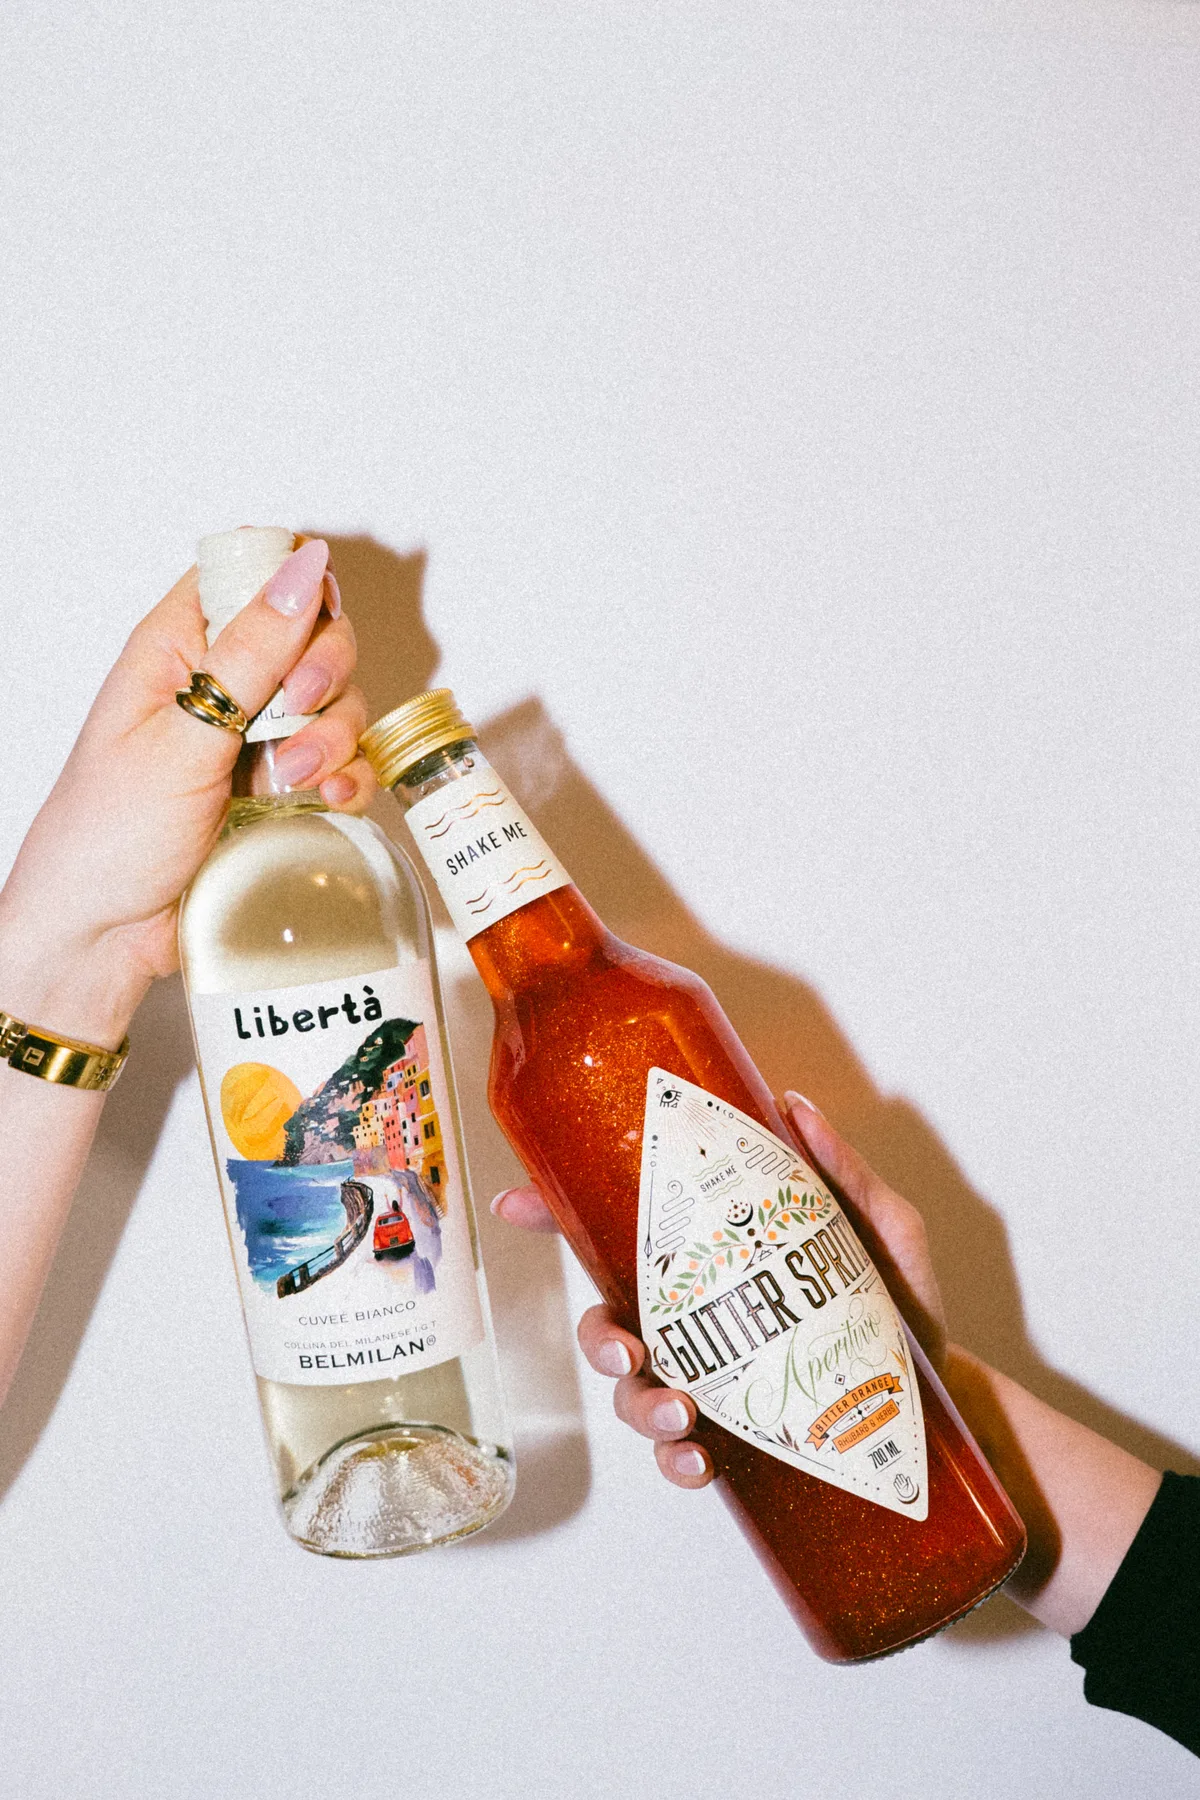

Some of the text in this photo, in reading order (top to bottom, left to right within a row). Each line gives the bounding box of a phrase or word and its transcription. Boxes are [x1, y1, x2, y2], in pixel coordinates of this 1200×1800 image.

[446, 822, 527, 876] SHAKE ME
[234, 985, 383, 1039] libertà
[700, 1164, 738, 1192] SHAKE ME
[355, 1300, 416, 1321] BIANCO
[657, 1269, 803, 1384] GLITTER
[284, 1341, 327, 1350] COLLINA
[329, 1339, 352, 1349] DEL
[355, 1328, 411, 1346] MILANESE
[745, 1297, 886, 1428] Aperitivo
[815, 1376, 890, 1433] BITTER ORANGE
[837, 1404, 896, 1449] RHUBARB & HERBS
[867, 1439, 902, 1470] 700 ML
